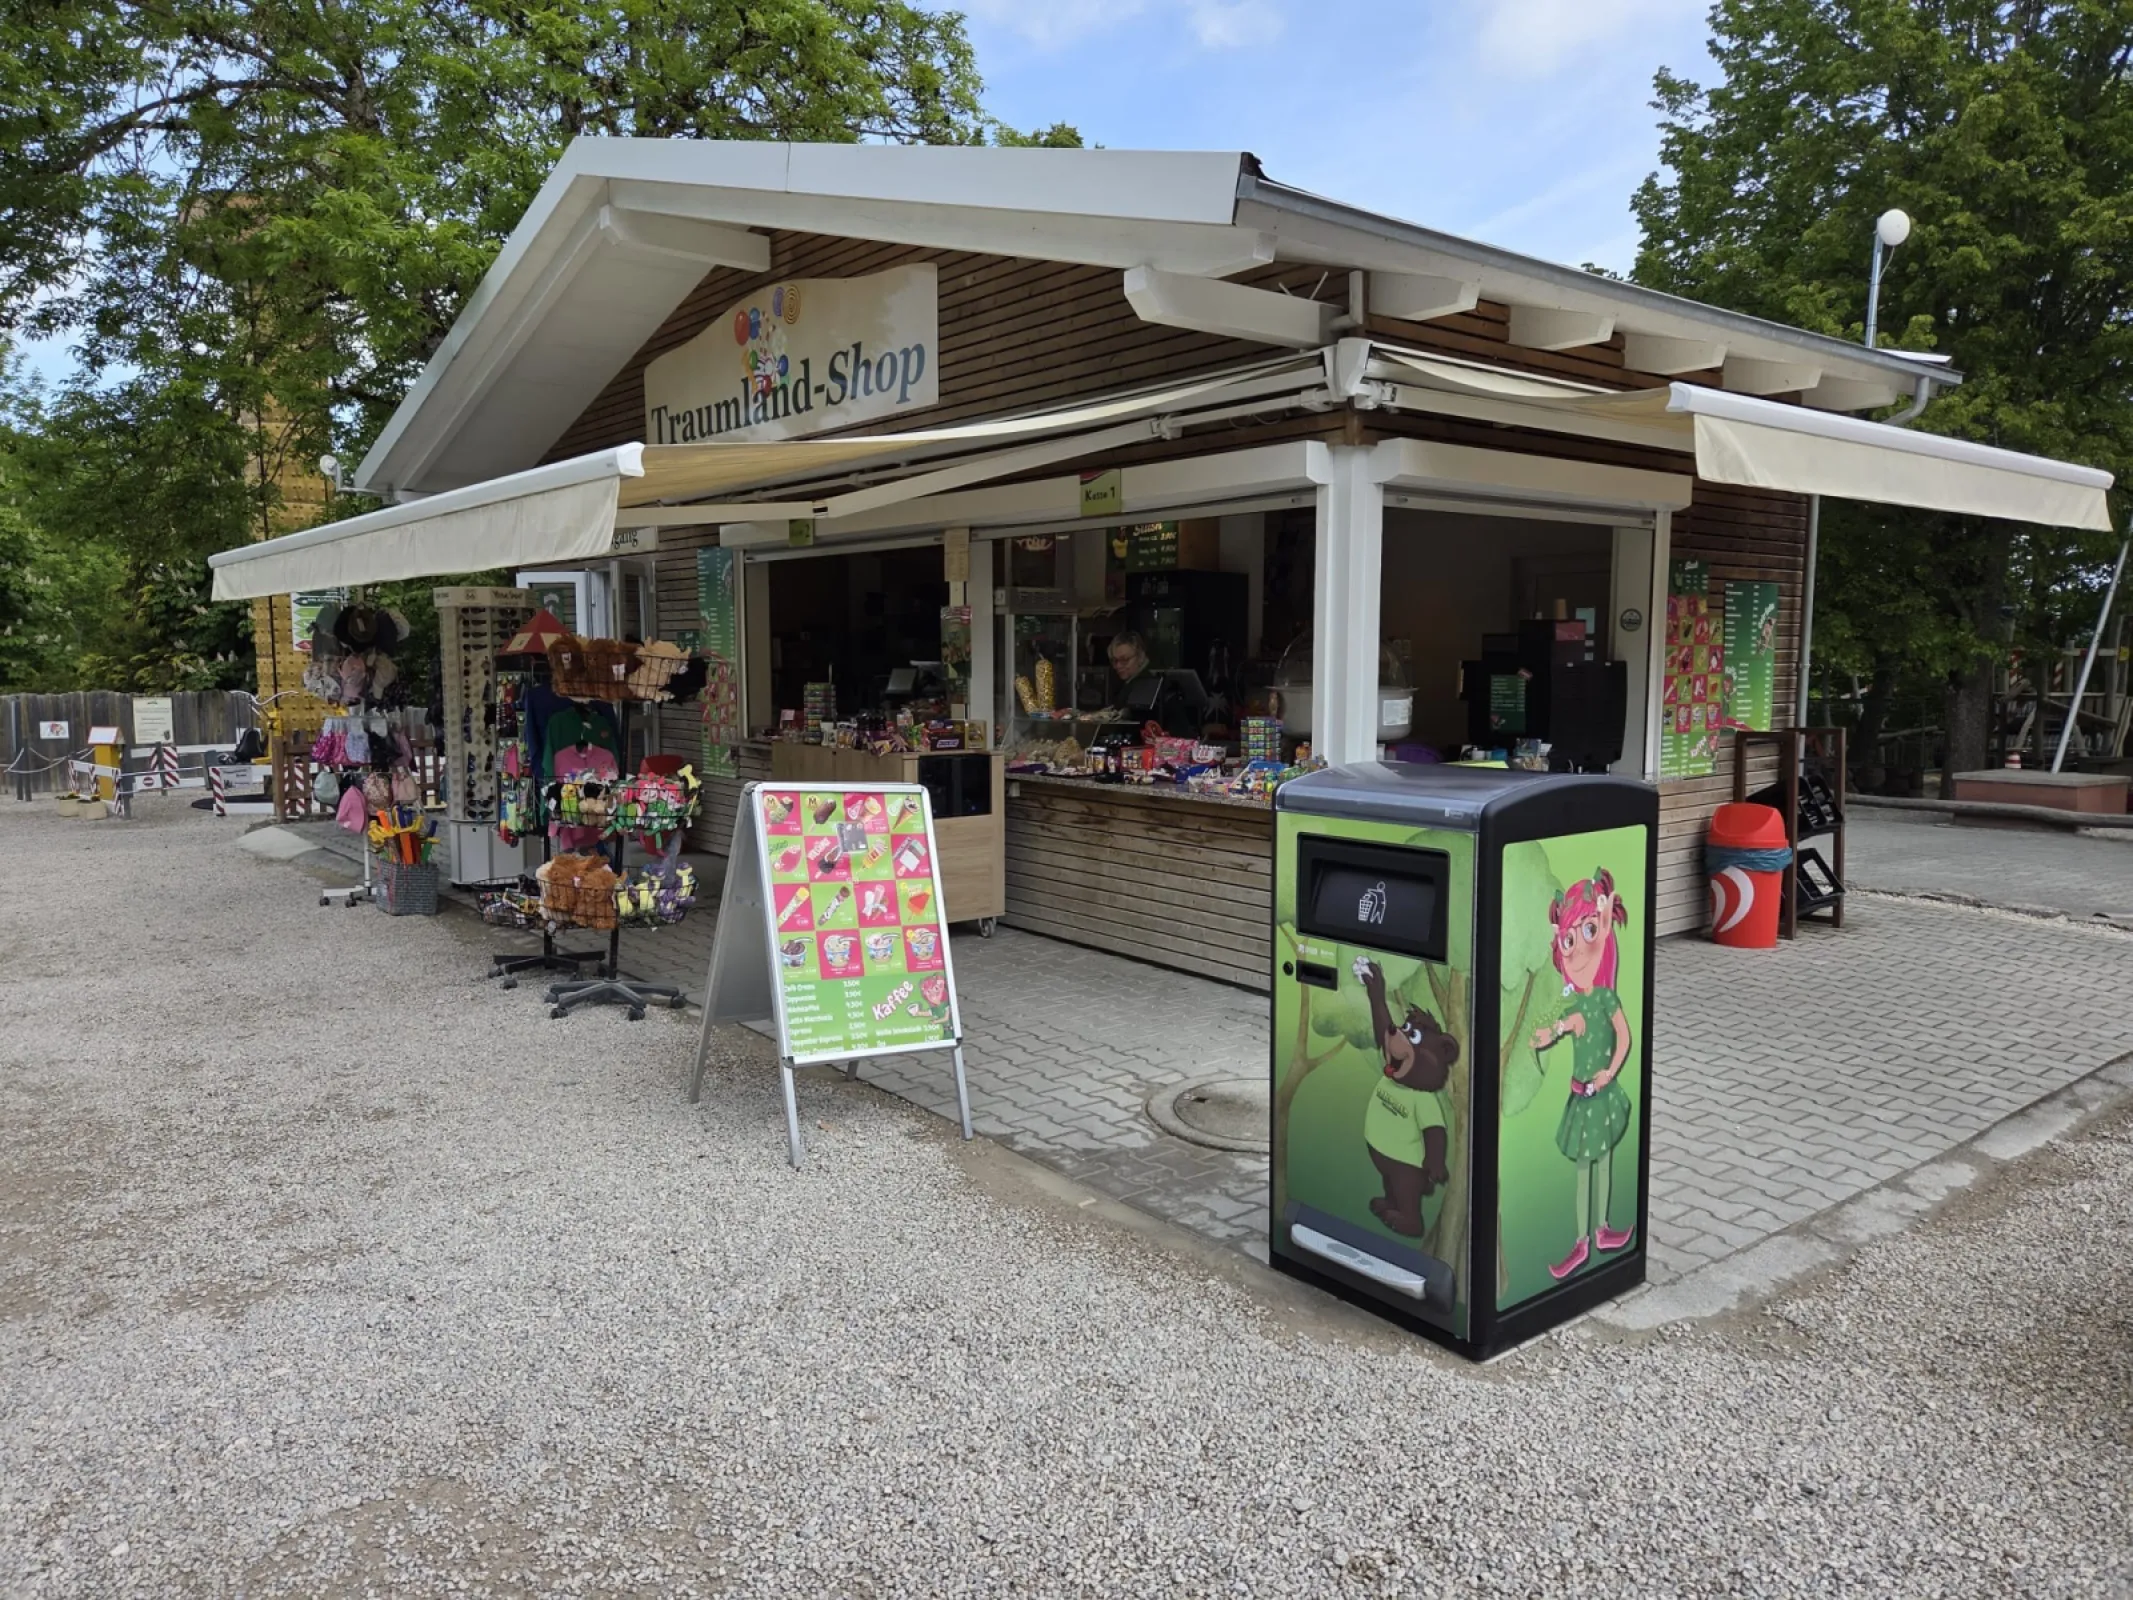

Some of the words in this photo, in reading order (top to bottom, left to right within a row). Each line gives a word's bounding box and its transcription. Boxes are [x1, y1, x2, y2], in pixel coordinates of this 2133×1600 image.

[651, 340, 926, 444] Traumland-Shop
[1085, 488, 1108, 502] Kasse
[1110, 486, 1116, 499] 1
[872, 979, 914, 1021] Kaffee
